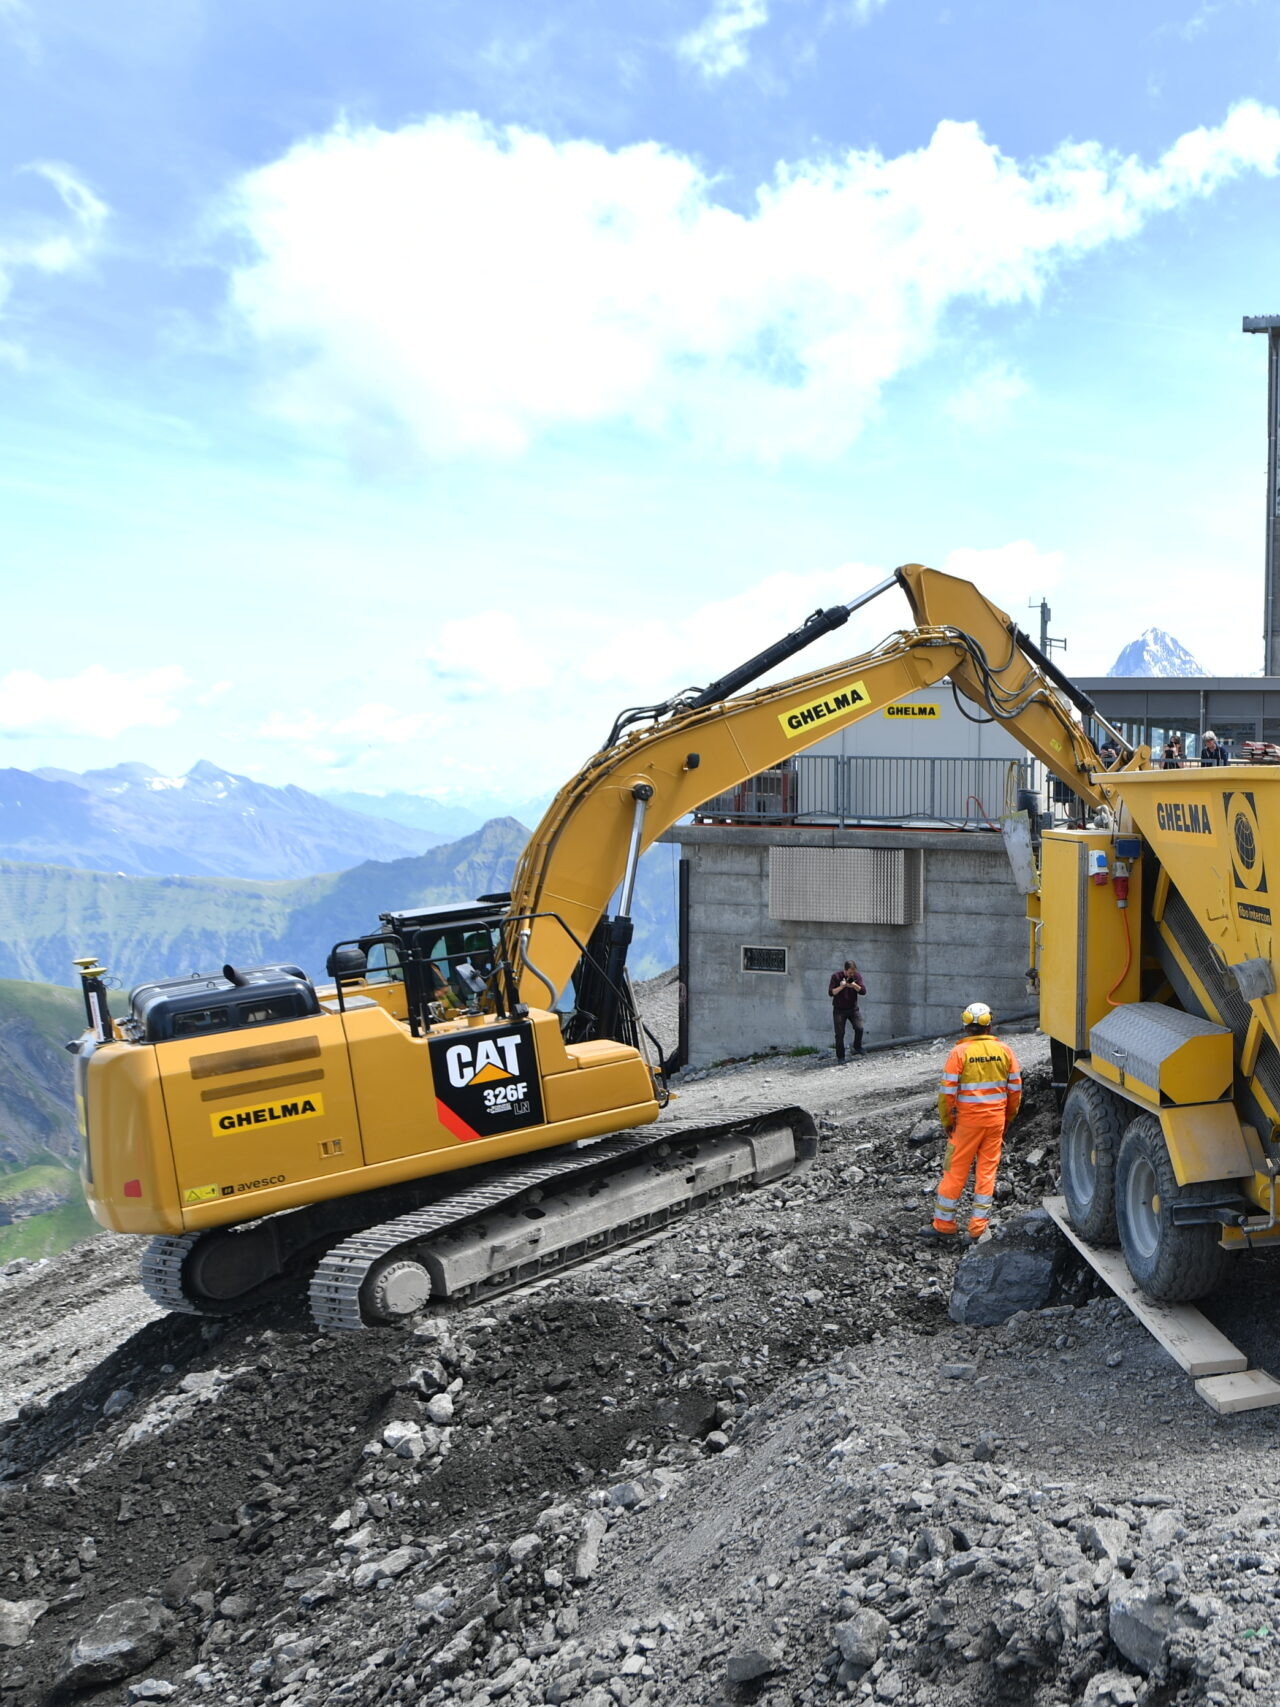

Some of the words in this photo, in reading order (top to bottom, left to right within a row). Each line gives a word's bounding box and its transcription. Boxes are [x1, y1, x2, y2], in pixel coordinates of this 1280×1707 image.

[787, 689, 864, 730] GHELMA
[887, 706, 936, 716] GHELMA
[1156, 802, 1212, 835] GHELMA
[446, 1034, 522, 1088] CAT
[483, 1082, 528, 1106] 326F
[219, 1100, 316, 1130] GHELMA
[513, 1101, 530, 1115] LN
[237, 1174, 286, 1192] avesco
